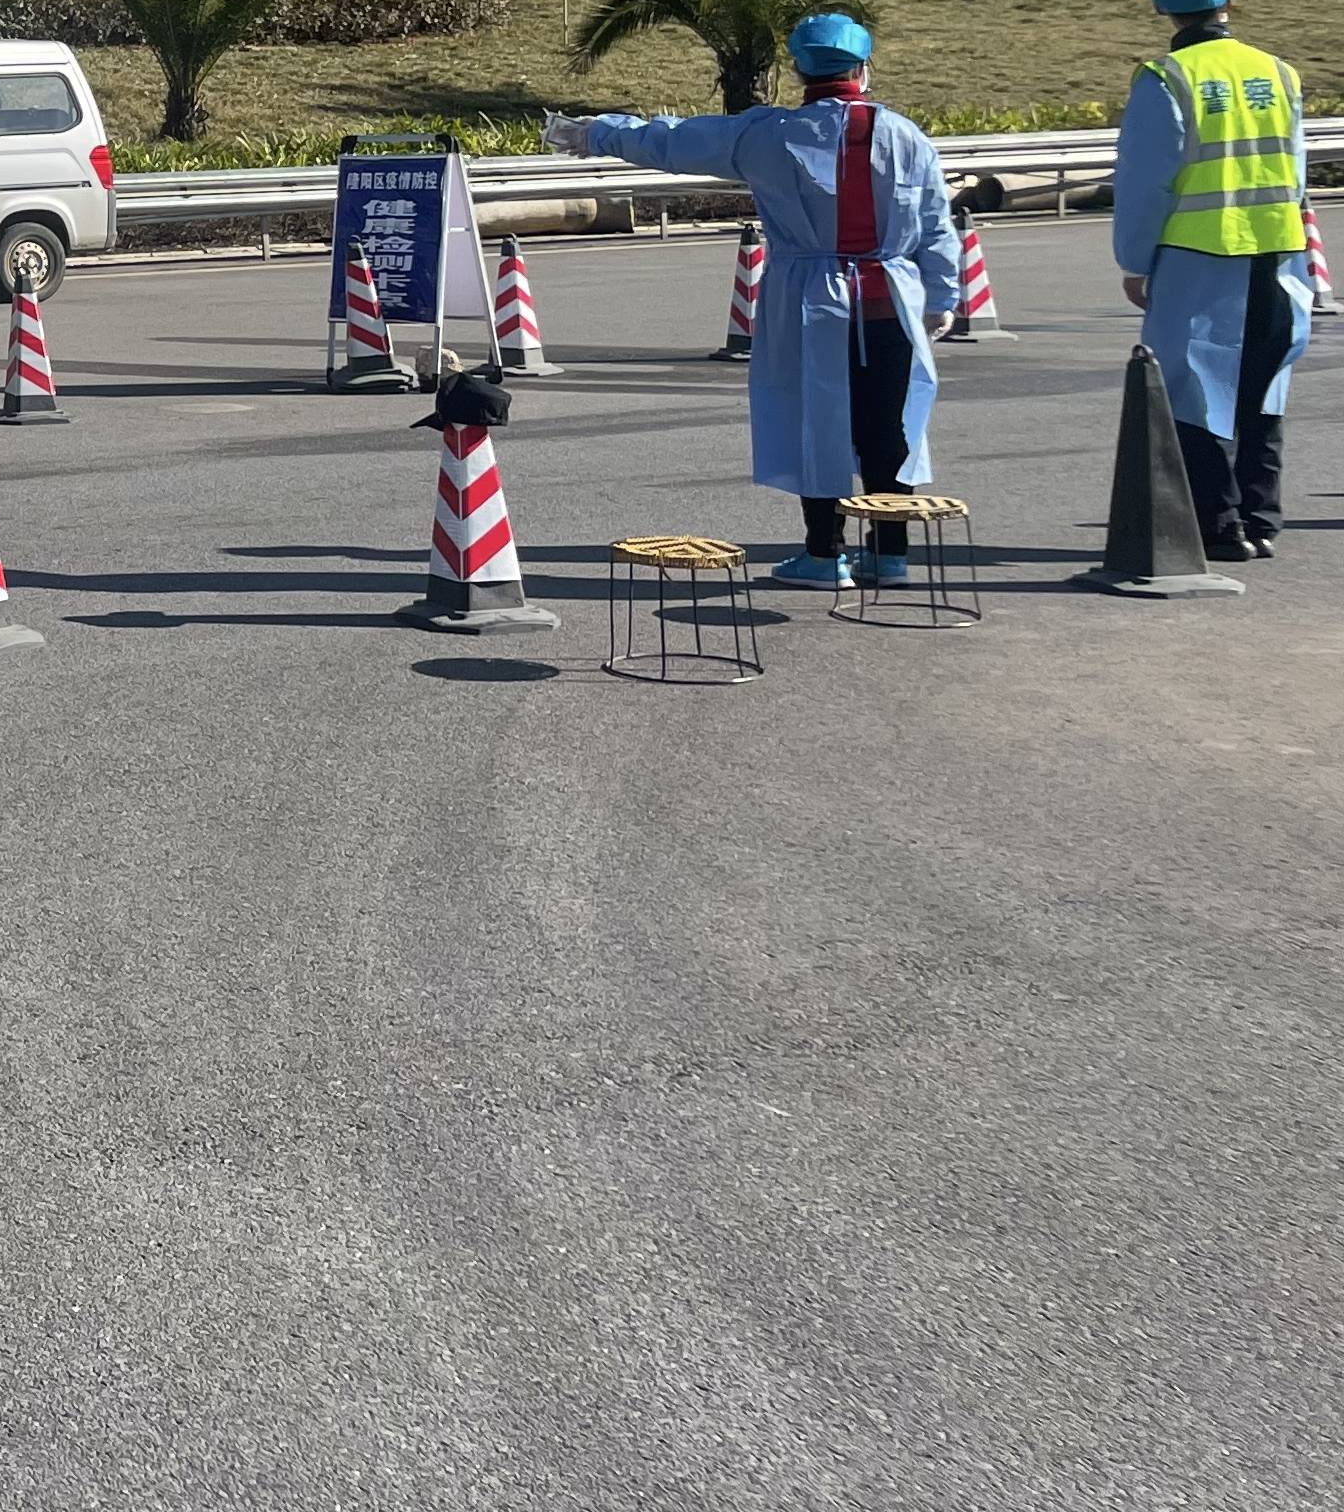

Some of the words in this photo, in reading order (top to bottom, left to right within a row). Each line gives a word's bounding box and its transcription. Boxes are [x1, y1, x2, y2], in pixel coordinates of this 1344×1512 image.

[1197, 78, 1276, 114] 警察
[346, 171, 438, 190] 隆阳区疫情防控
[361, 199, 418, 308] 健康检测卡点
